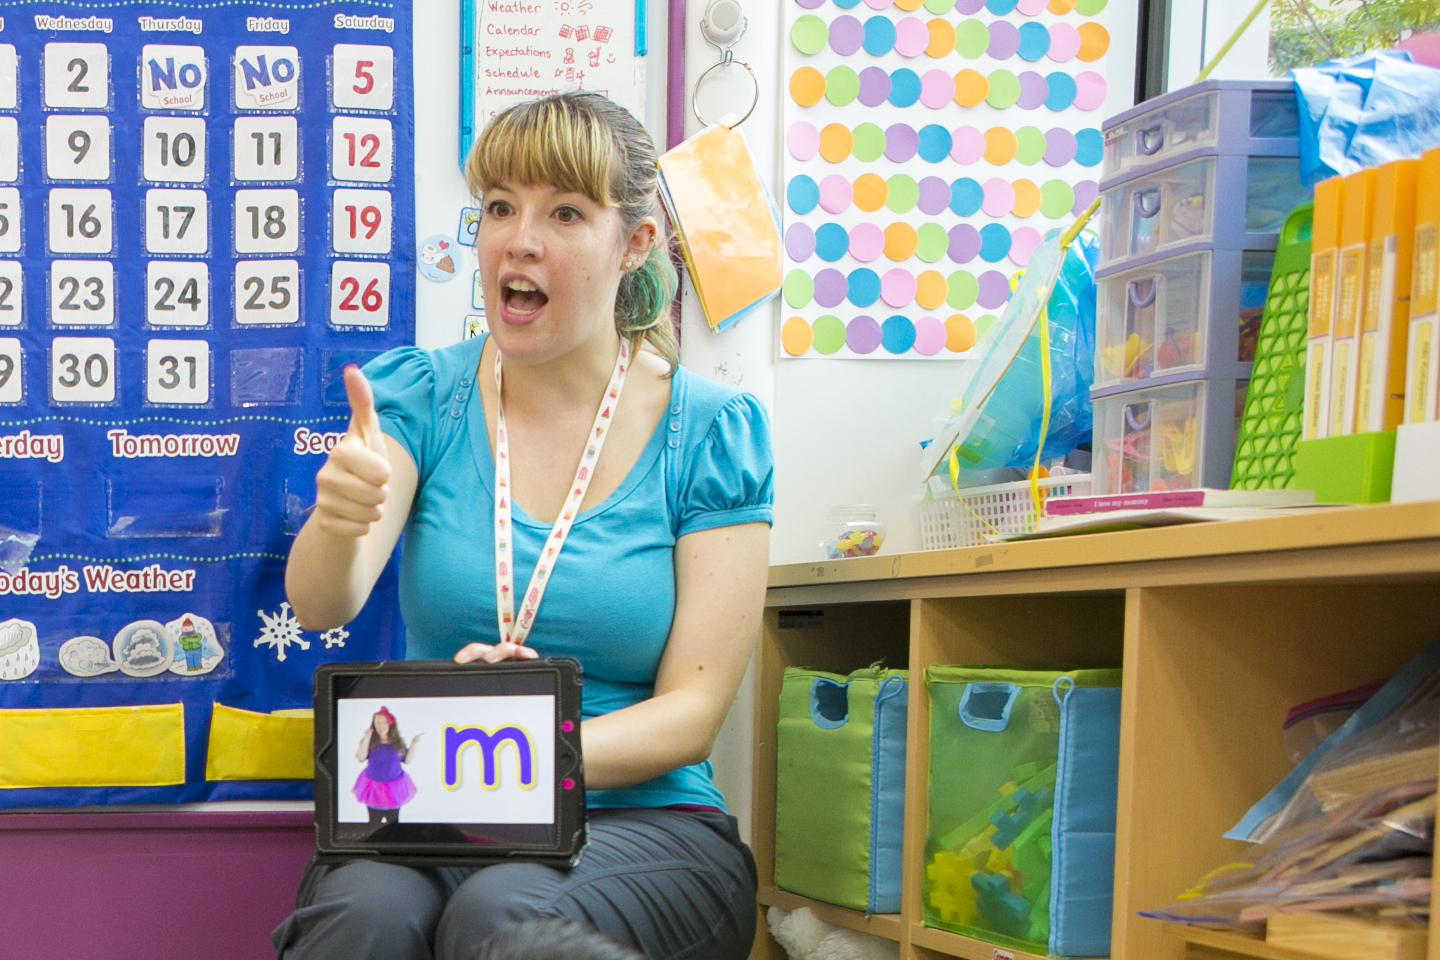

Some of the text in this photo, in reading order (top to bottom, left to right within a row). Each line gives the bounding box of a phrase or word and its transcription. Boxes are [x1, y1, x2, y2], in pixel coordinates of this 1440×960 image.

[488, 0, 542, 14] Weather
[36, 15, 113, 32] Wednesday
[140, 17, 202, 33] Thursday
[248, 17, 289, 33] Friday
[335, 15, 394, 31] Saturday
[487, 23, 541, 36] Calendar
[485, 46, 552, 61] Expectations
[67, 57, 90, 93] 2
[148, 57, 203, 92] No
[239, 54, 295, 91] No
[352, 60, 375, 95] 5
[163, 95, 193, 106] School
[259, 89, 289, 104] School
[67, 129, 91, 165] 9
[155, 131, 196, 168] 10
[250, 131, 282, 166] 11
[343, 132, 381, 168] 12
[60, 203, 102, 239] 16
[156, 205, 196, 240] 17
[245, 205, 287, 240] 18
[344, 205, 382, 240] 19
[58, 275, 106, 312] 23
[153, 276, 202, 312] 24
[243, 275, 291, 310] 25
[338, 276, 383, 313] 26
[58, 353, 109, 390] 30
[158, 355, 197, 390] 31
[109, 430, 239, 458] Tomorrow
[295, 429, 347, 454] Sea
[84, 565, 195, 592] Weather
[442, 723, 537, 790] m
